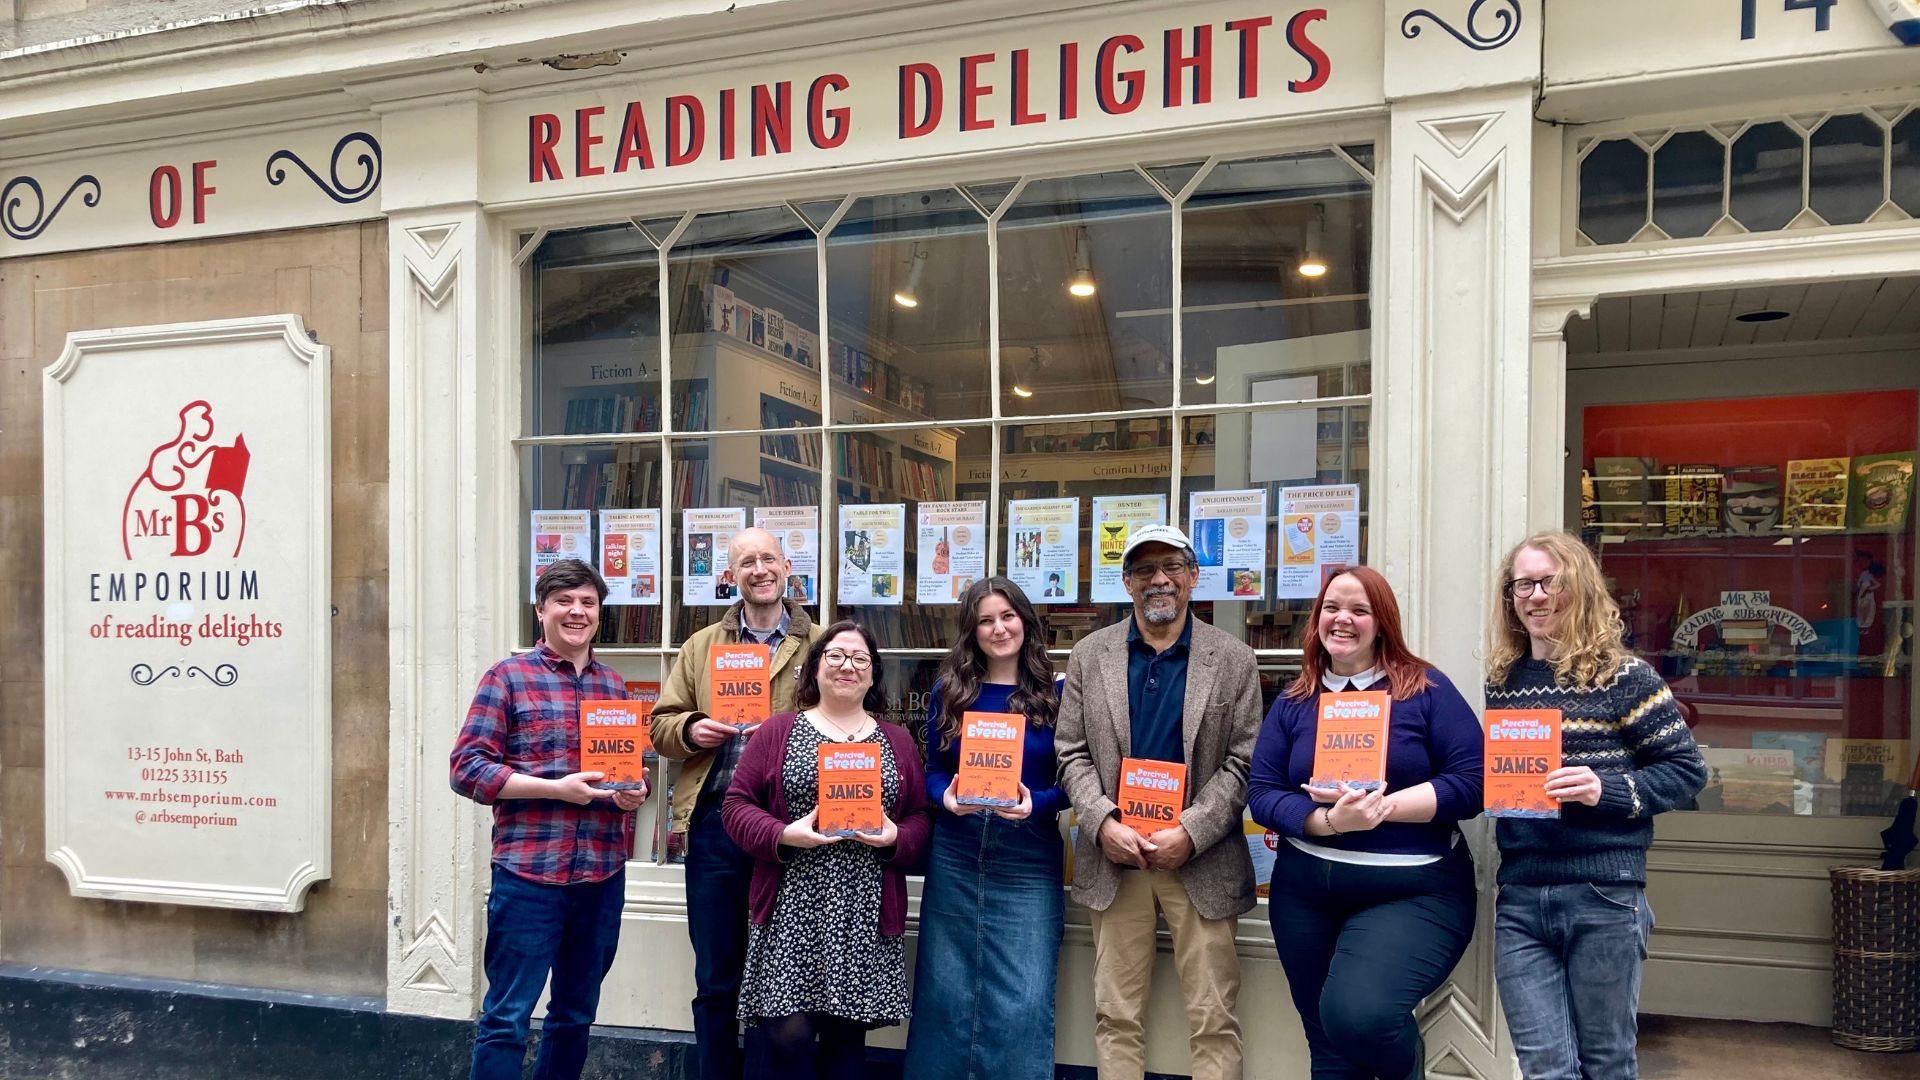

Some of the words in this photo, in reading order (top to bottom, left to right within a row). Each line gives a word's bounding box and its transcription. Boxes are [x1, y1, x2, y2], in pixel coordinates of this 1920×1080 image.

[529, 73, 851, 183] READING
[899, 8, 1331, 139] DELIGHTS
[150, 160, 216, 228] OF
[591, 363, 632, 380] Fiction
[638, 361, 647, 377] A
[779, 381, 800, 400] Fiction
[1021, 469, 1028, 478] Z
[1093, 463, 1137, 476] Criminal
[1202, 495, 1254, 503] ENLIGHTENMENT
[135, 509, 172, 537] Mr
[91, 570, 259, 602] EMPORIUM
[90, 614, 112, 639] of
[116, 615, 192, 646] reading
[198, 613, 283, 646] delights
[1677, 608, 1724, 642] READING
[1733, 607, 1813, 642] SUBSCRIPTIONS
[716, 656, 764, 669] Everett
[717, 681, 762, 697] JAMES
[1335, 699, 1369, 708] Percival
[586, 713, 637, 726] Everett
[596, 708, 627, 716] Percival
[1323, 705, 1380, 720] Everett
[977, 719, 1008, 728] Percival
[1502, 719, 1539, 728] Percival
[967, 724, 1017, 740] Everett
[1490, 724, 1551, 740] Everett
[588, 739, 635, 754] JAMES
[1322, 733, 1375, 750] JAMES
[128, 747, 160, 761] 13-15
[163, 748, 192, 764] John
[196, 749, 212, 764] St,
[215, 749, 243, 764] Bath
[834, 751, 865, 759] Percival
[966, 752, 1012, 769] JAMES
[824, 757, 876, 770] Everett
[1491, 756, 1548, 774] JAMES
[142, 768, 179, 783] 01225
[182, 769, 228, 785] 331155
[1125, 771, 1179, 792] Everett
[1137, 768, 1169, 780] Percival
[104, 788, 277, 808] www.mrbsemporium.com
[826, 784, 873, 800] JAMES
[1124, 800, 1174, 822] JAMES
